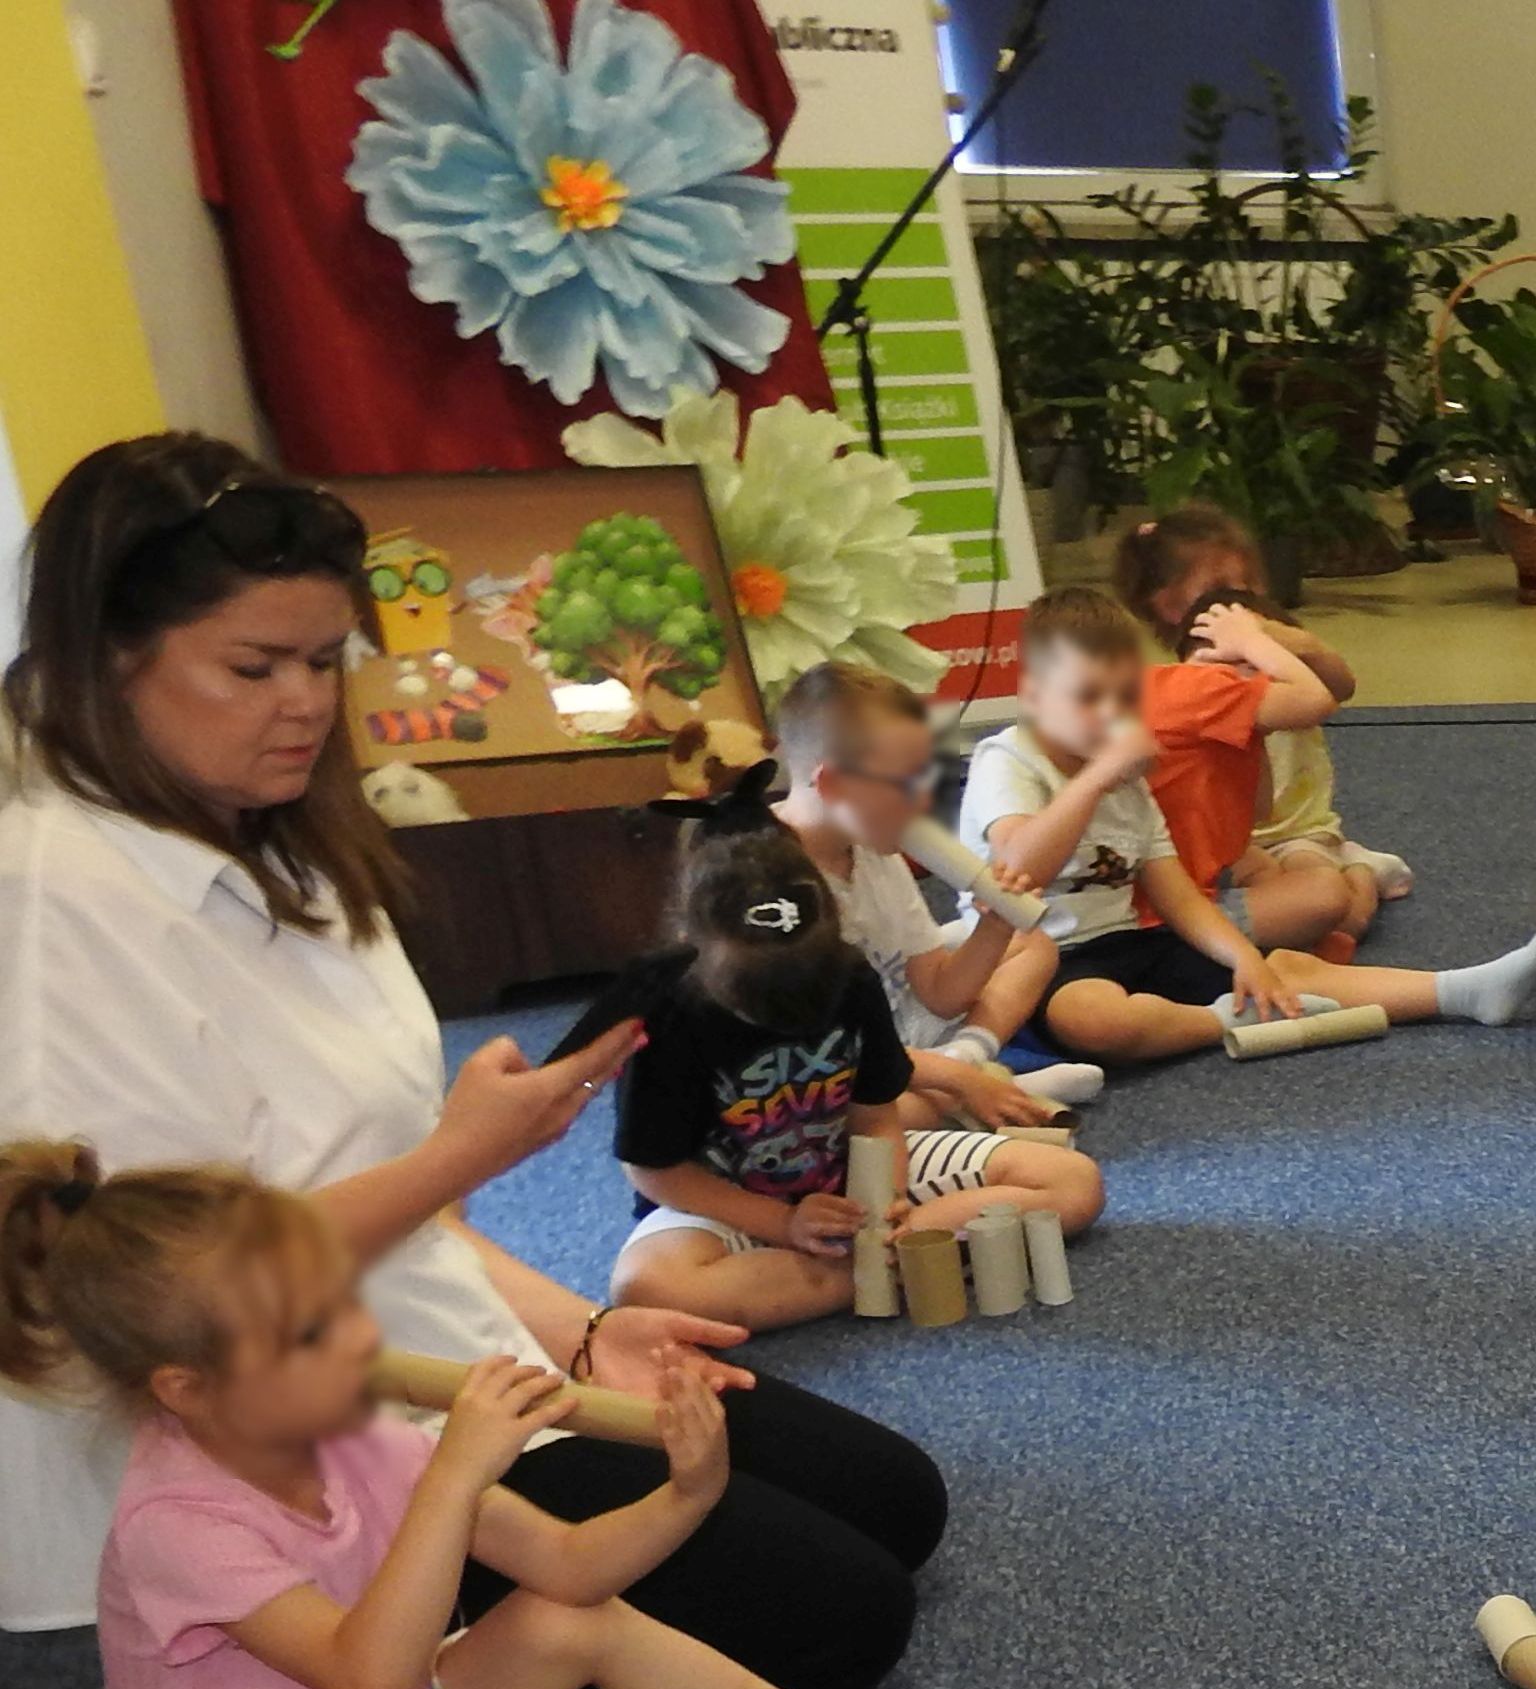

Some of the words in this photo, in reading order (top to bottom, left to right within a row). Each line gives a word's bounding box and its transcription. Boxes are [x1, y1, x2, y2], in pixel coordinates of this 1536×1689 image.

[770, 16, 897, 52] bliczna
[741, 1029, 843, 1097] SIX
[721, 1068, 858, 1136] SEVE
